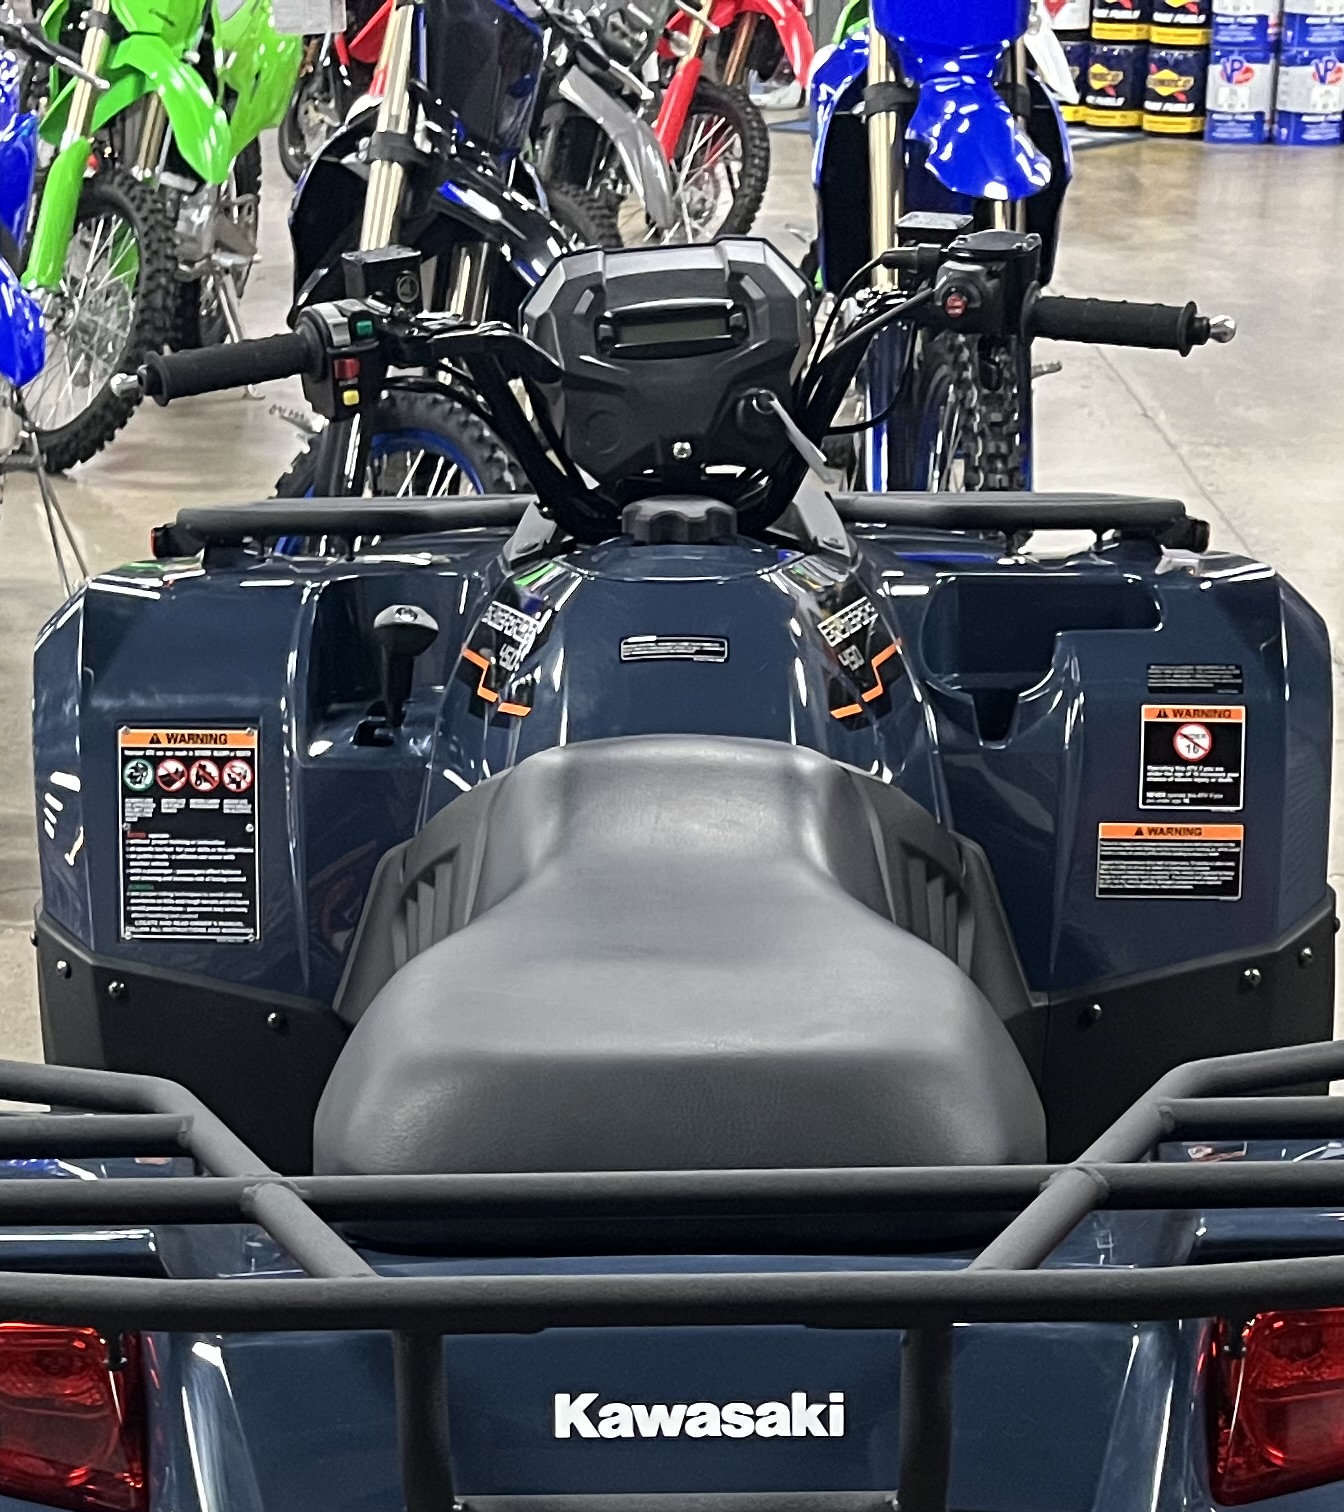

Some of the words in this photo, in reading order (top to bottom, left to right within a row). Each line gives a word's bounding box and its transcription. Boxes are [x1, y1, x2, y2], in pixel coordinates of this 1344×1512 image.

[1172, 709, 1232, 719] WARNING
[166, 733, 228, 745] WARNING
[1147, 826, 1203, 837] WARNING
[554, 1392, 844, 1439] Kawasaki
